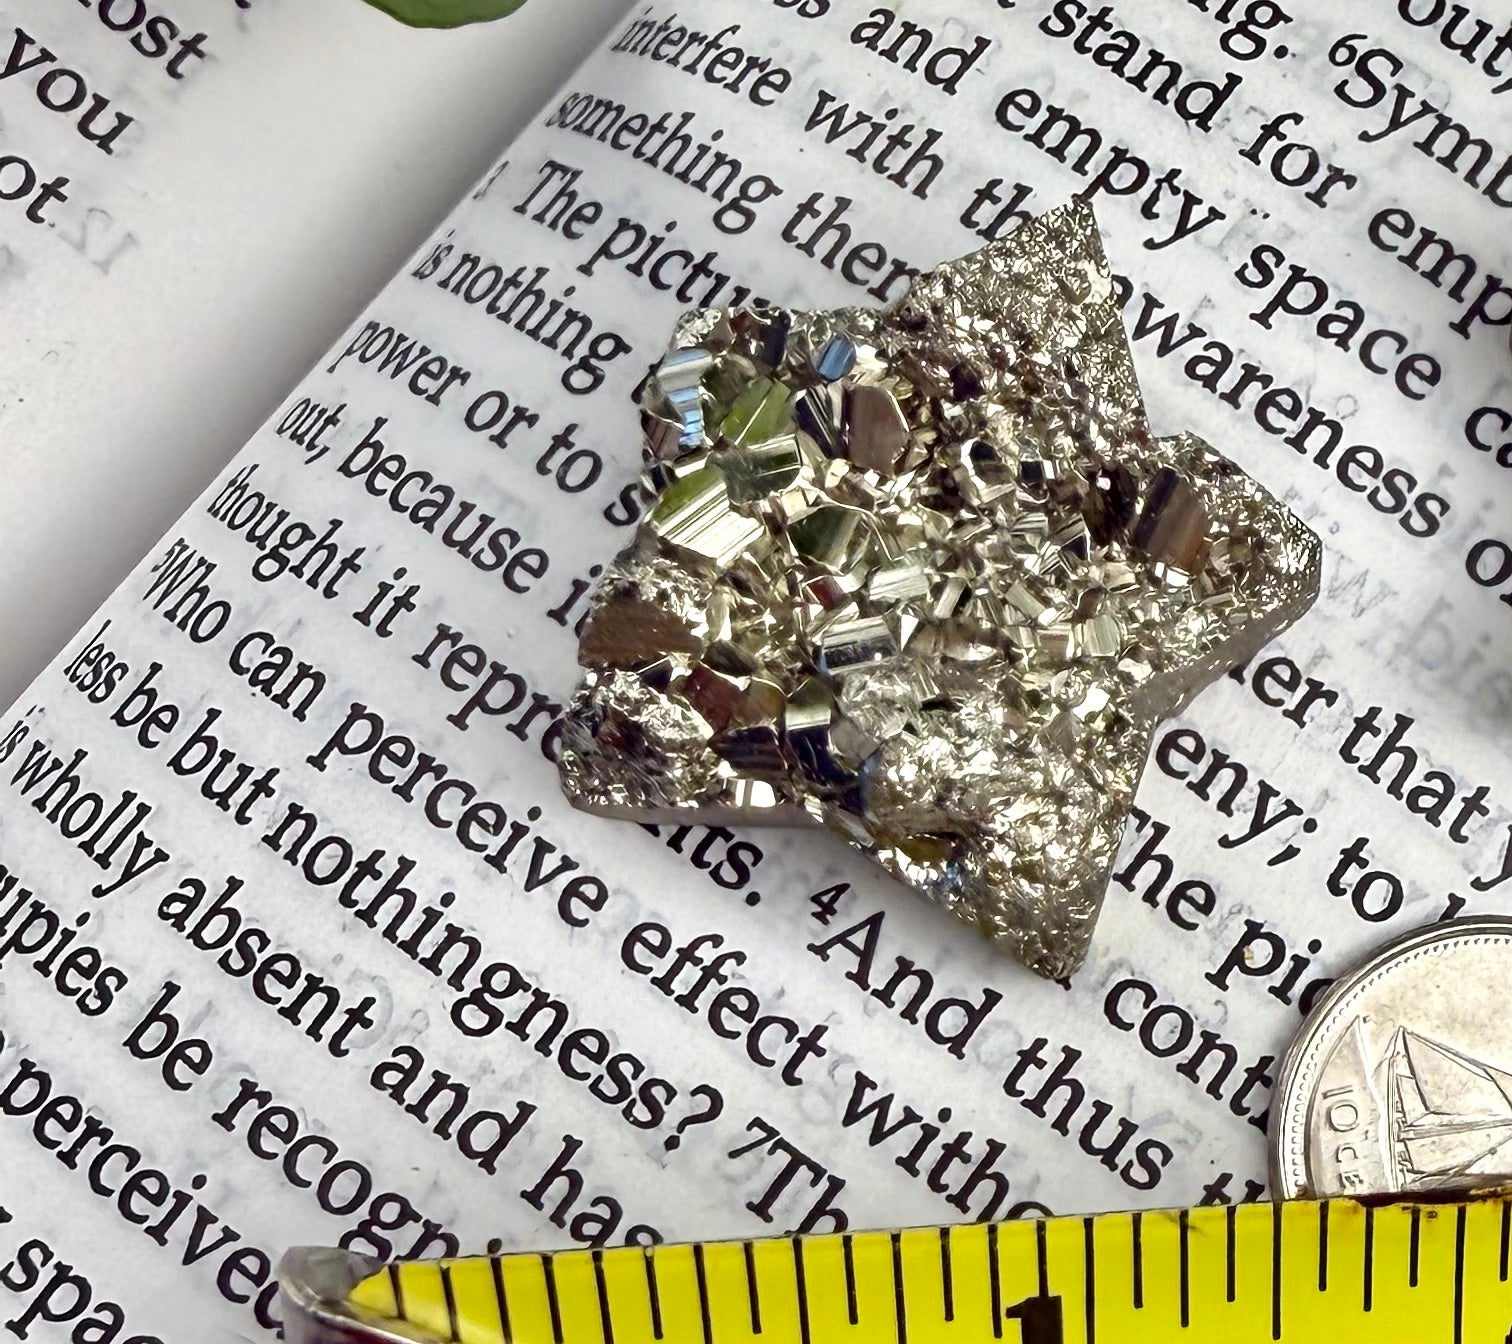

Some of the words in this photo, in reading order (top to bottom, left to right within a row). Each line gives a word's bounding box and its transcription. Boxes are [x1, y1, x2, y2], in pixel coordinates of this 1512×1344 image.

[513, 160, 602, 239] The
[805, 90, 943, 200] with
[851, 9, 991, 95] and
[995, 89, 1226, 250] empty
[1235, 245, 1441, 400] space
[1239, 113, 1357, 208] for
[327, 321, 470, 406] power
[464, 391, 539, 449] or
[536, 424, 602, 493] to
[437, 254, 632, 395] nothing
[337, 417, 548, 593] because
[207, 464, 366, 599] thought
[353, 567, 420, 637] it
[1003, 1038, 1173, 1190] thus
[229, 632, 326, 722] can
[306, 703, 608, 927] perceive
[621, 922, 828, 1086] effect
[1339, 707, 1490, 843] that
[11, 740, 170, 898] wholly
[158, 876, 376, 1057] absent
[370, 1046, 537, 1175] and
[110, 662, 179, 748] be
[167, 708, 280, 825] but
[261, 802, 723, 1152] nothingness?
[122, 981, 212, 1091] be
